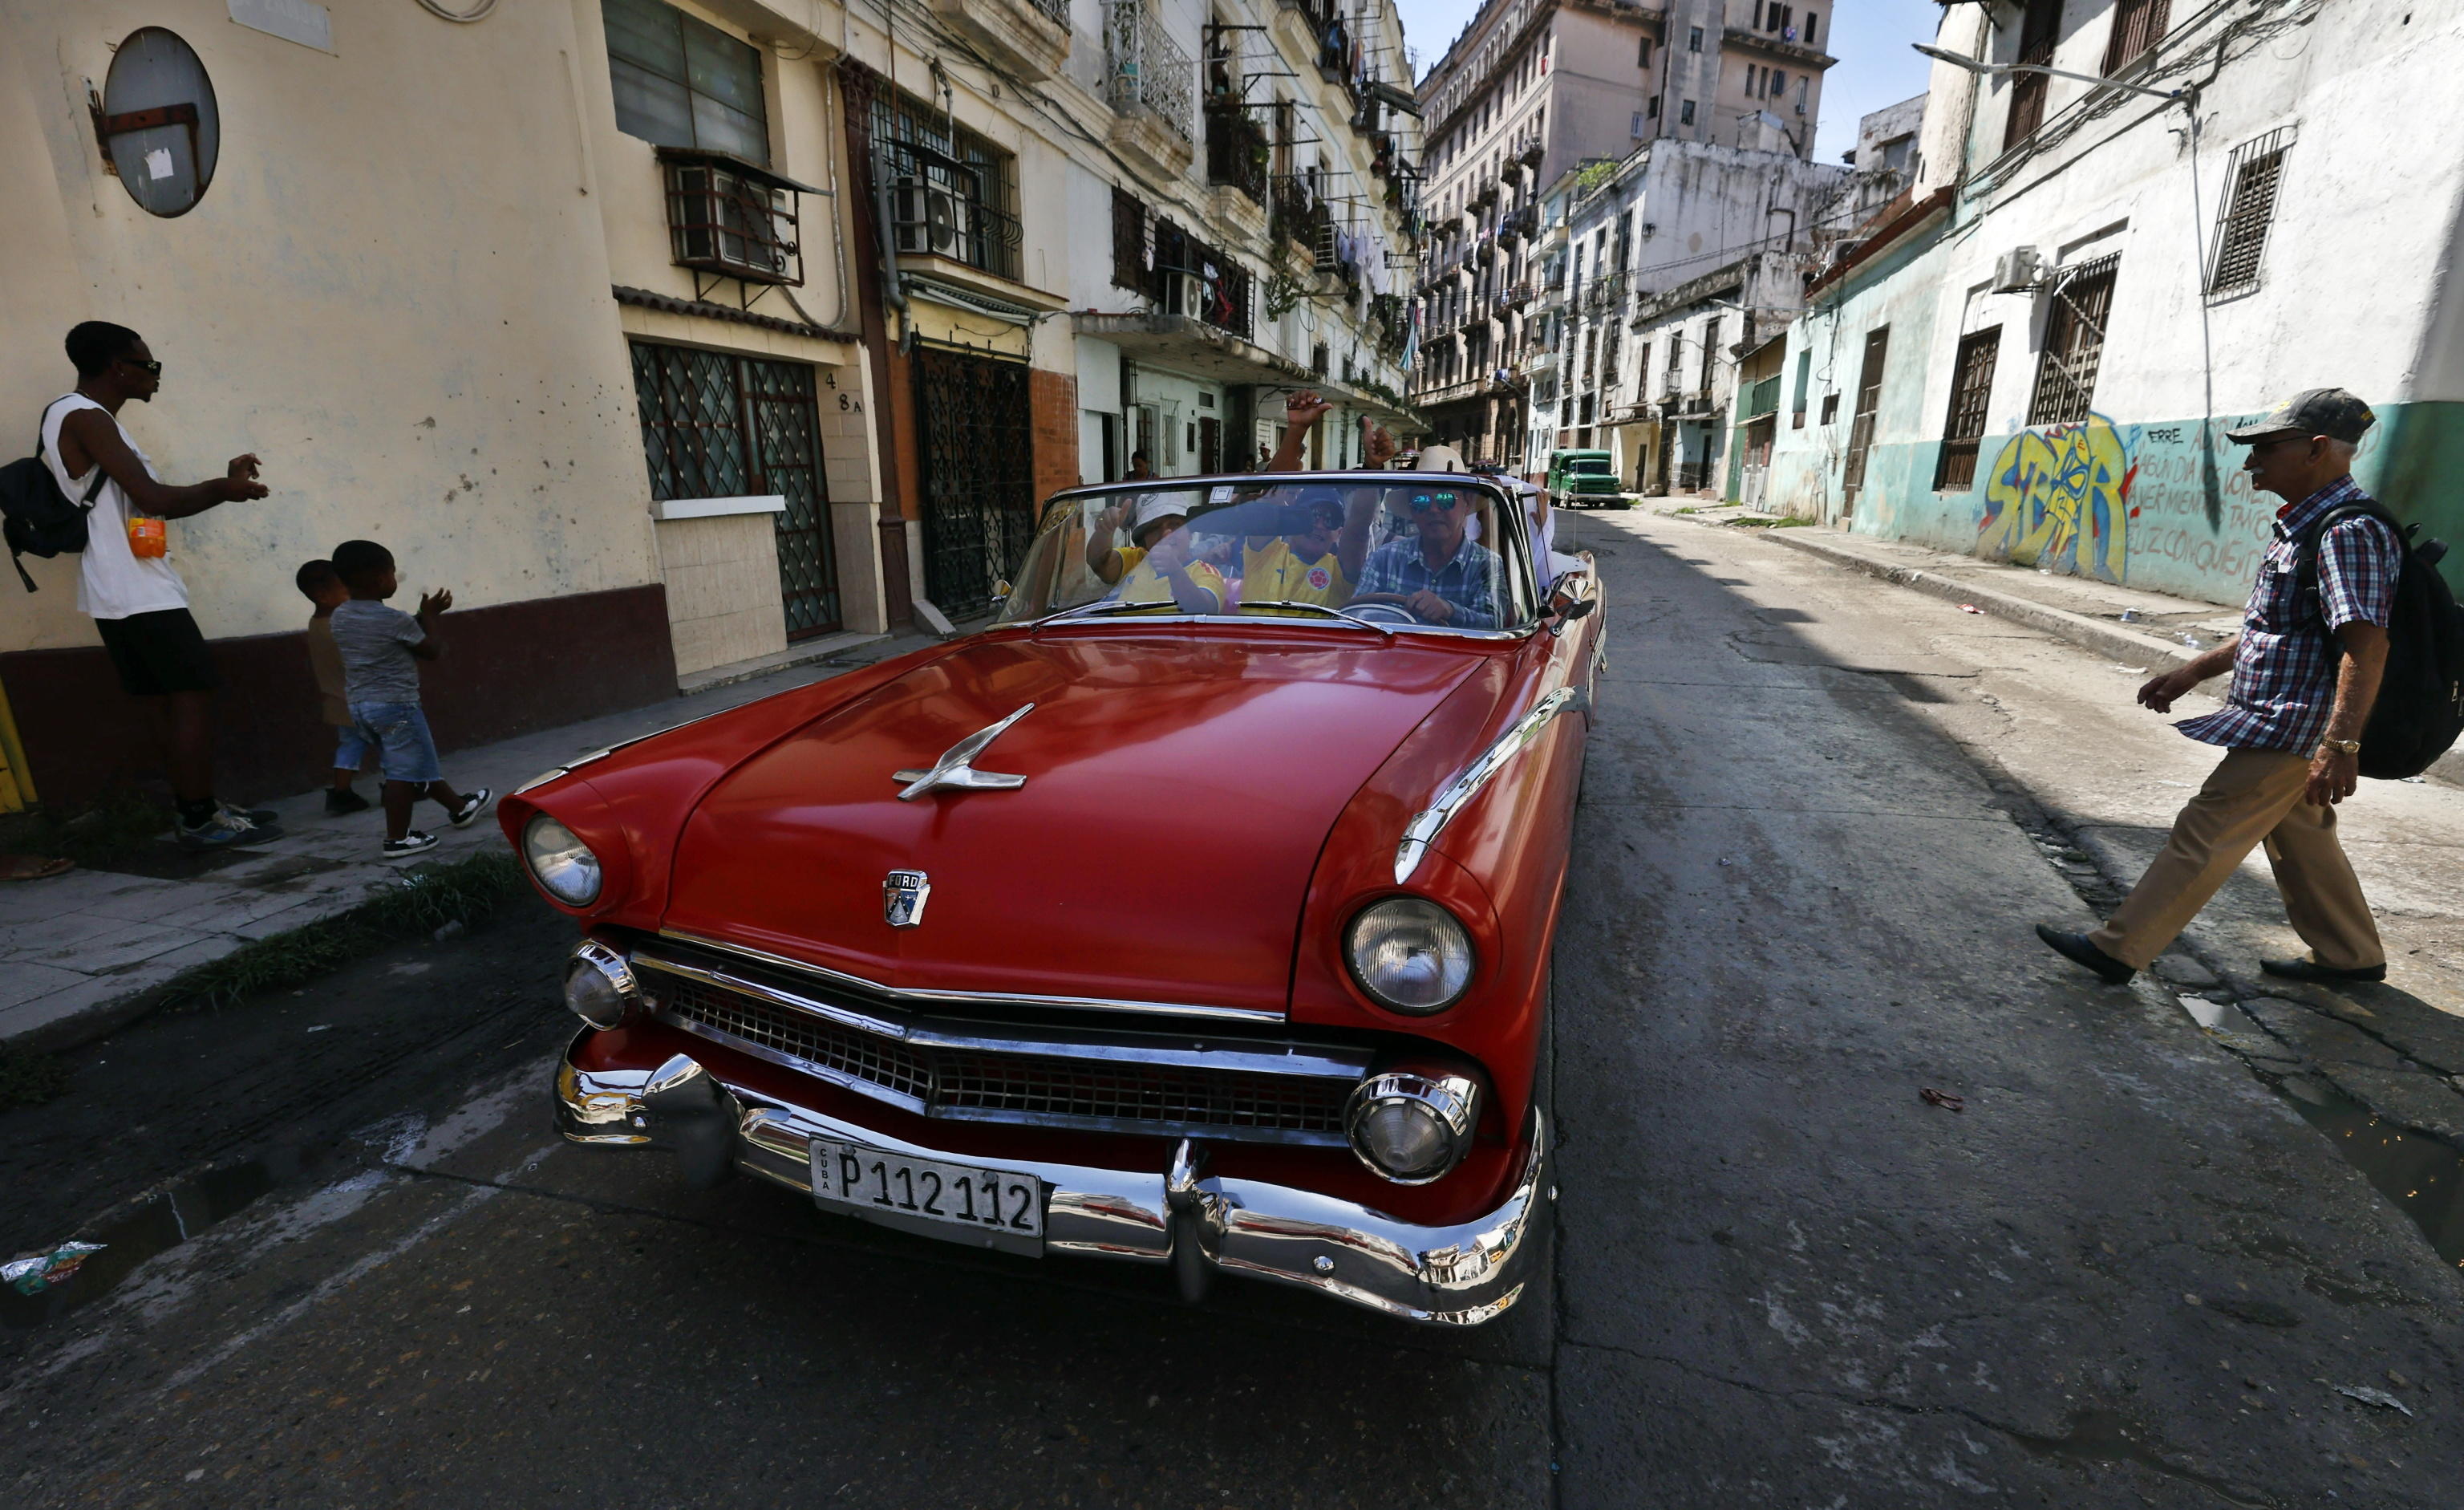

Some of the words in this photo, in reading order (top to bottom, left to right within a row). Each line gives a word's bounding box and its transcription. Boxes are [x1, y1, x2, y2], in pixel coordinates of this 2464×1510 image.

[2148, 428, 2183, 444] ERRE
[889, 875, 919, 888] FORD
[820, 1148, 829, 1191] CUBA
